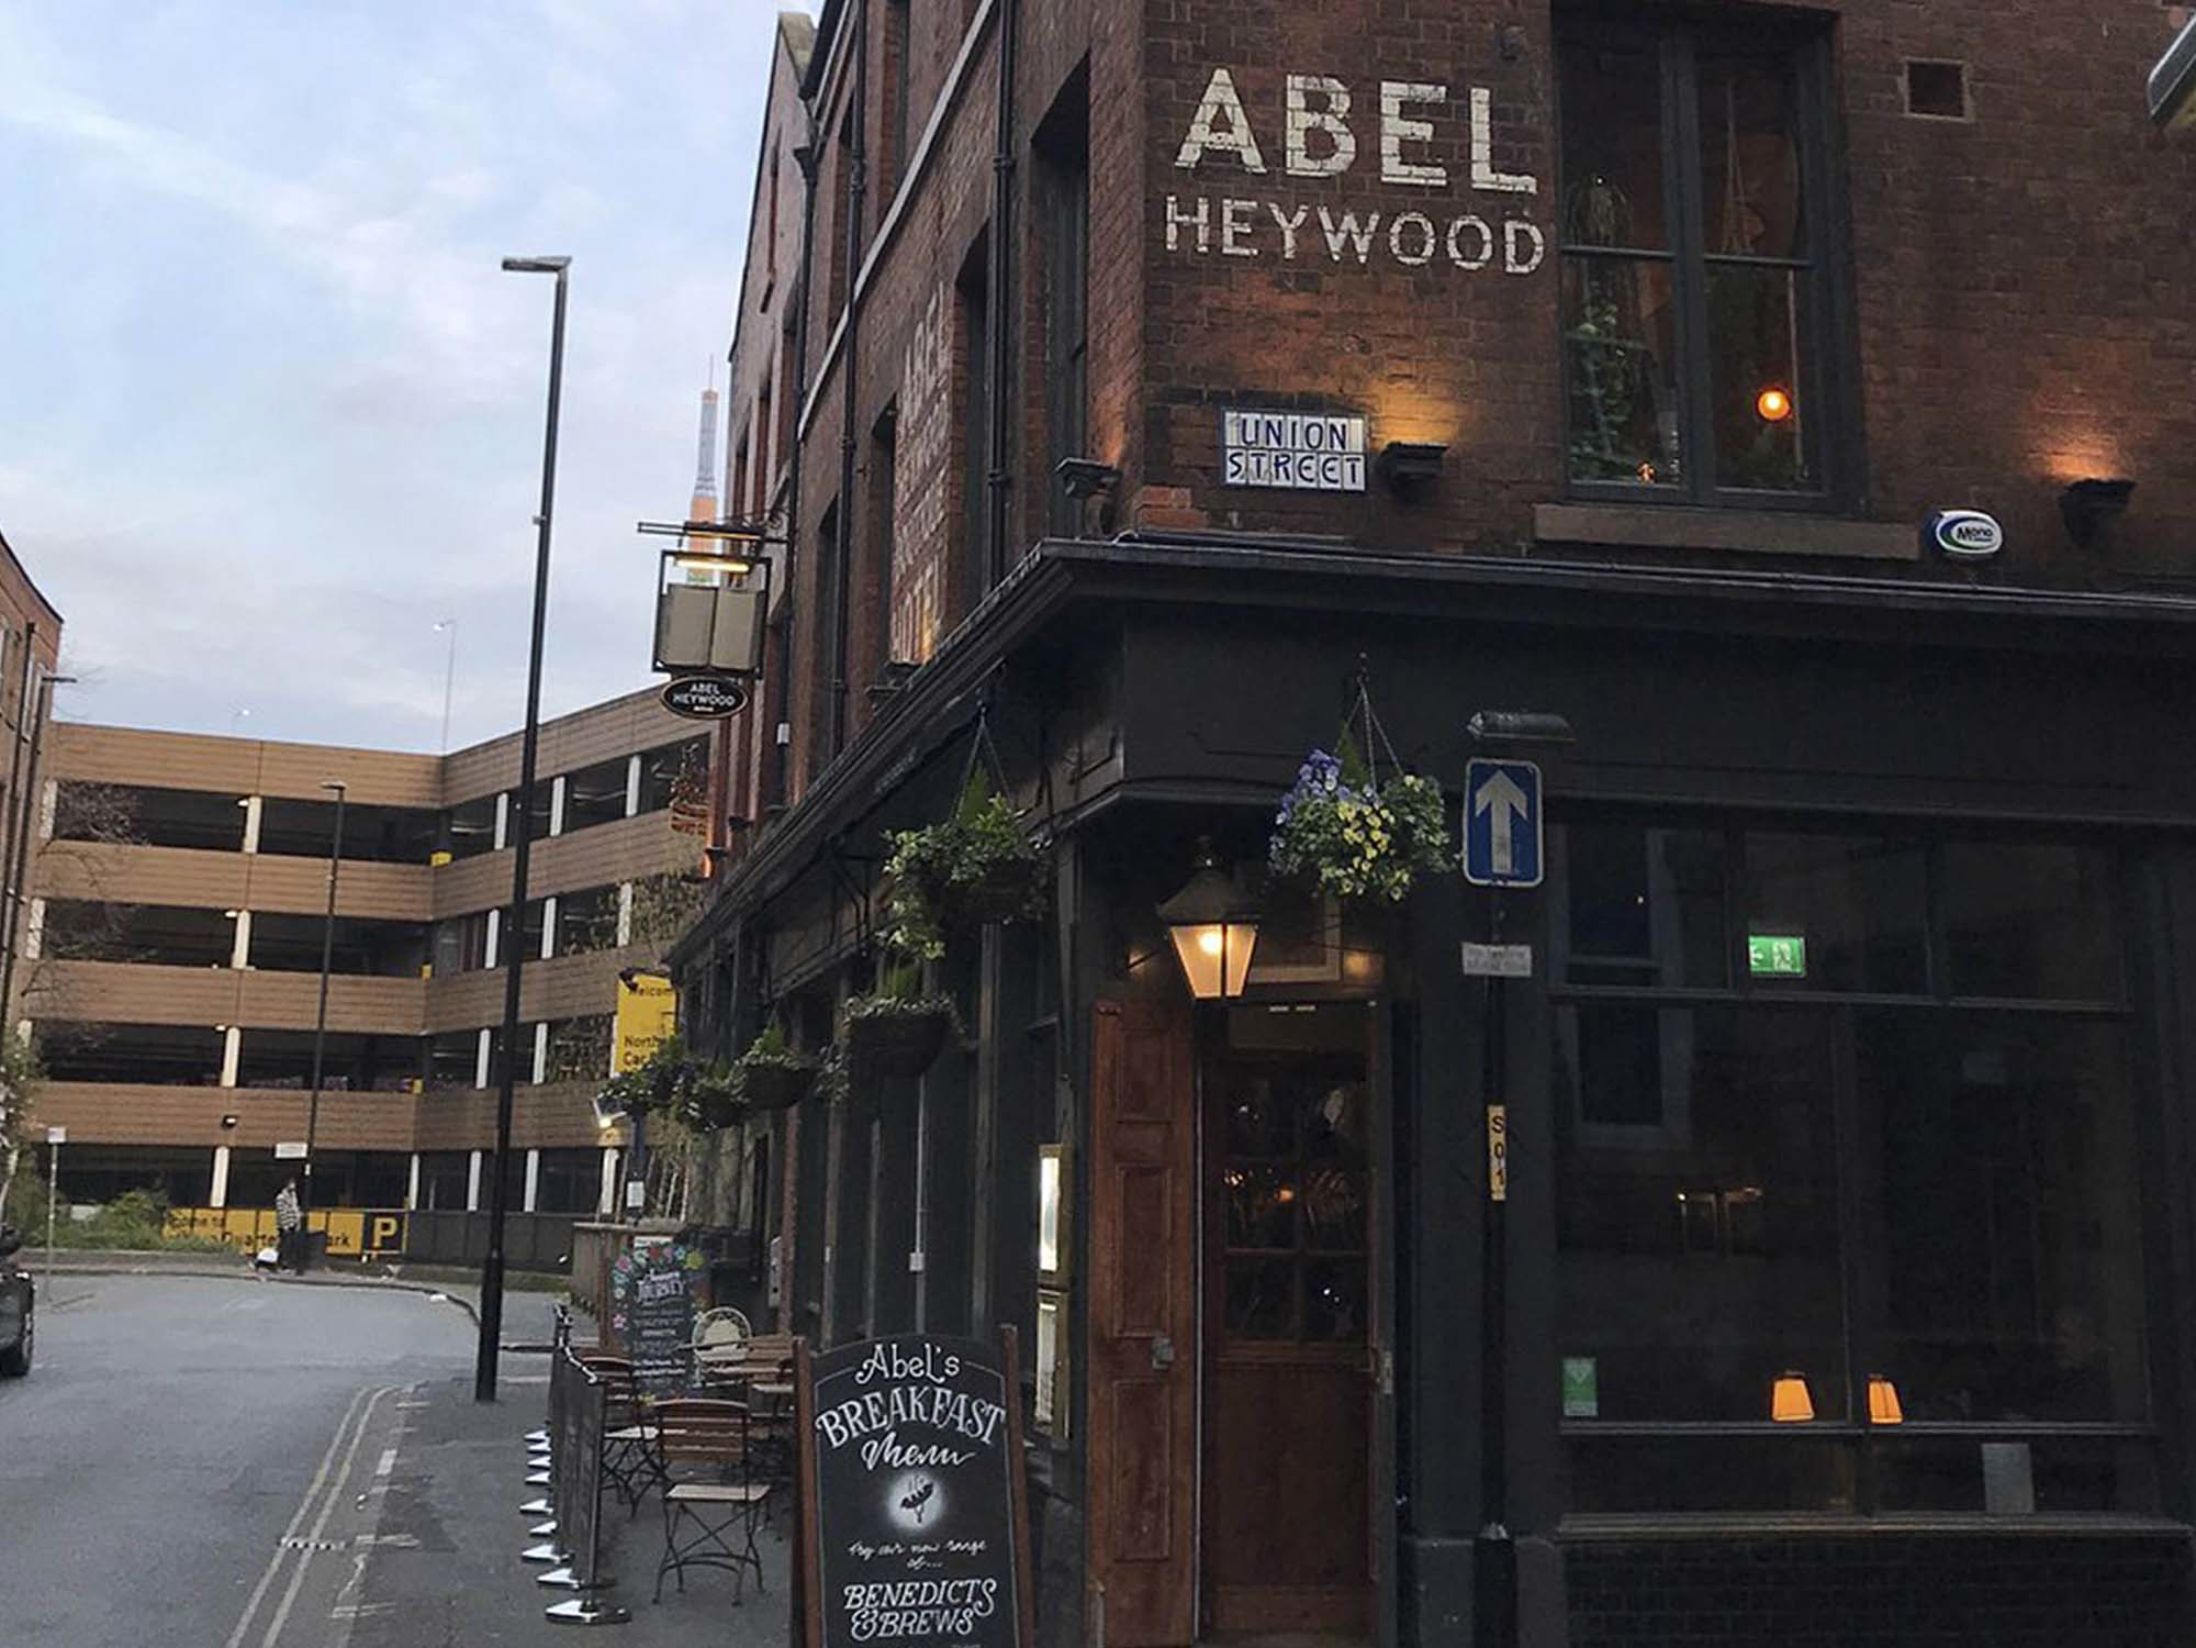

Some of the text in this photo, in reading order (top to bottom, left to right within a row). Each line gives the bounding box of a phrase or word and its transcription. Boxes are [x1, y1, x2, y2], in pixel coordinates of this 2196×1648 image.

[1175, 68, 1537, 194] ABEL
[1166, 195, 1544, 274] HEYWOOD
[1242, 418, 1347, 449] UNION
[1228, 452, 1361, 484] STREET
[672, 693, 736, 707] HEYWOOD
[690, 683, 720, 695] ABEL
[372, 1217, 398, 1248] P
[855, 1343, 960, 1385] Abel's
[815, 1385, 1006, 1450] BREAKFAST
[861, 1431, 976, 1472] Menu
[844, 1577, 998, 1617] BENEDICTS
